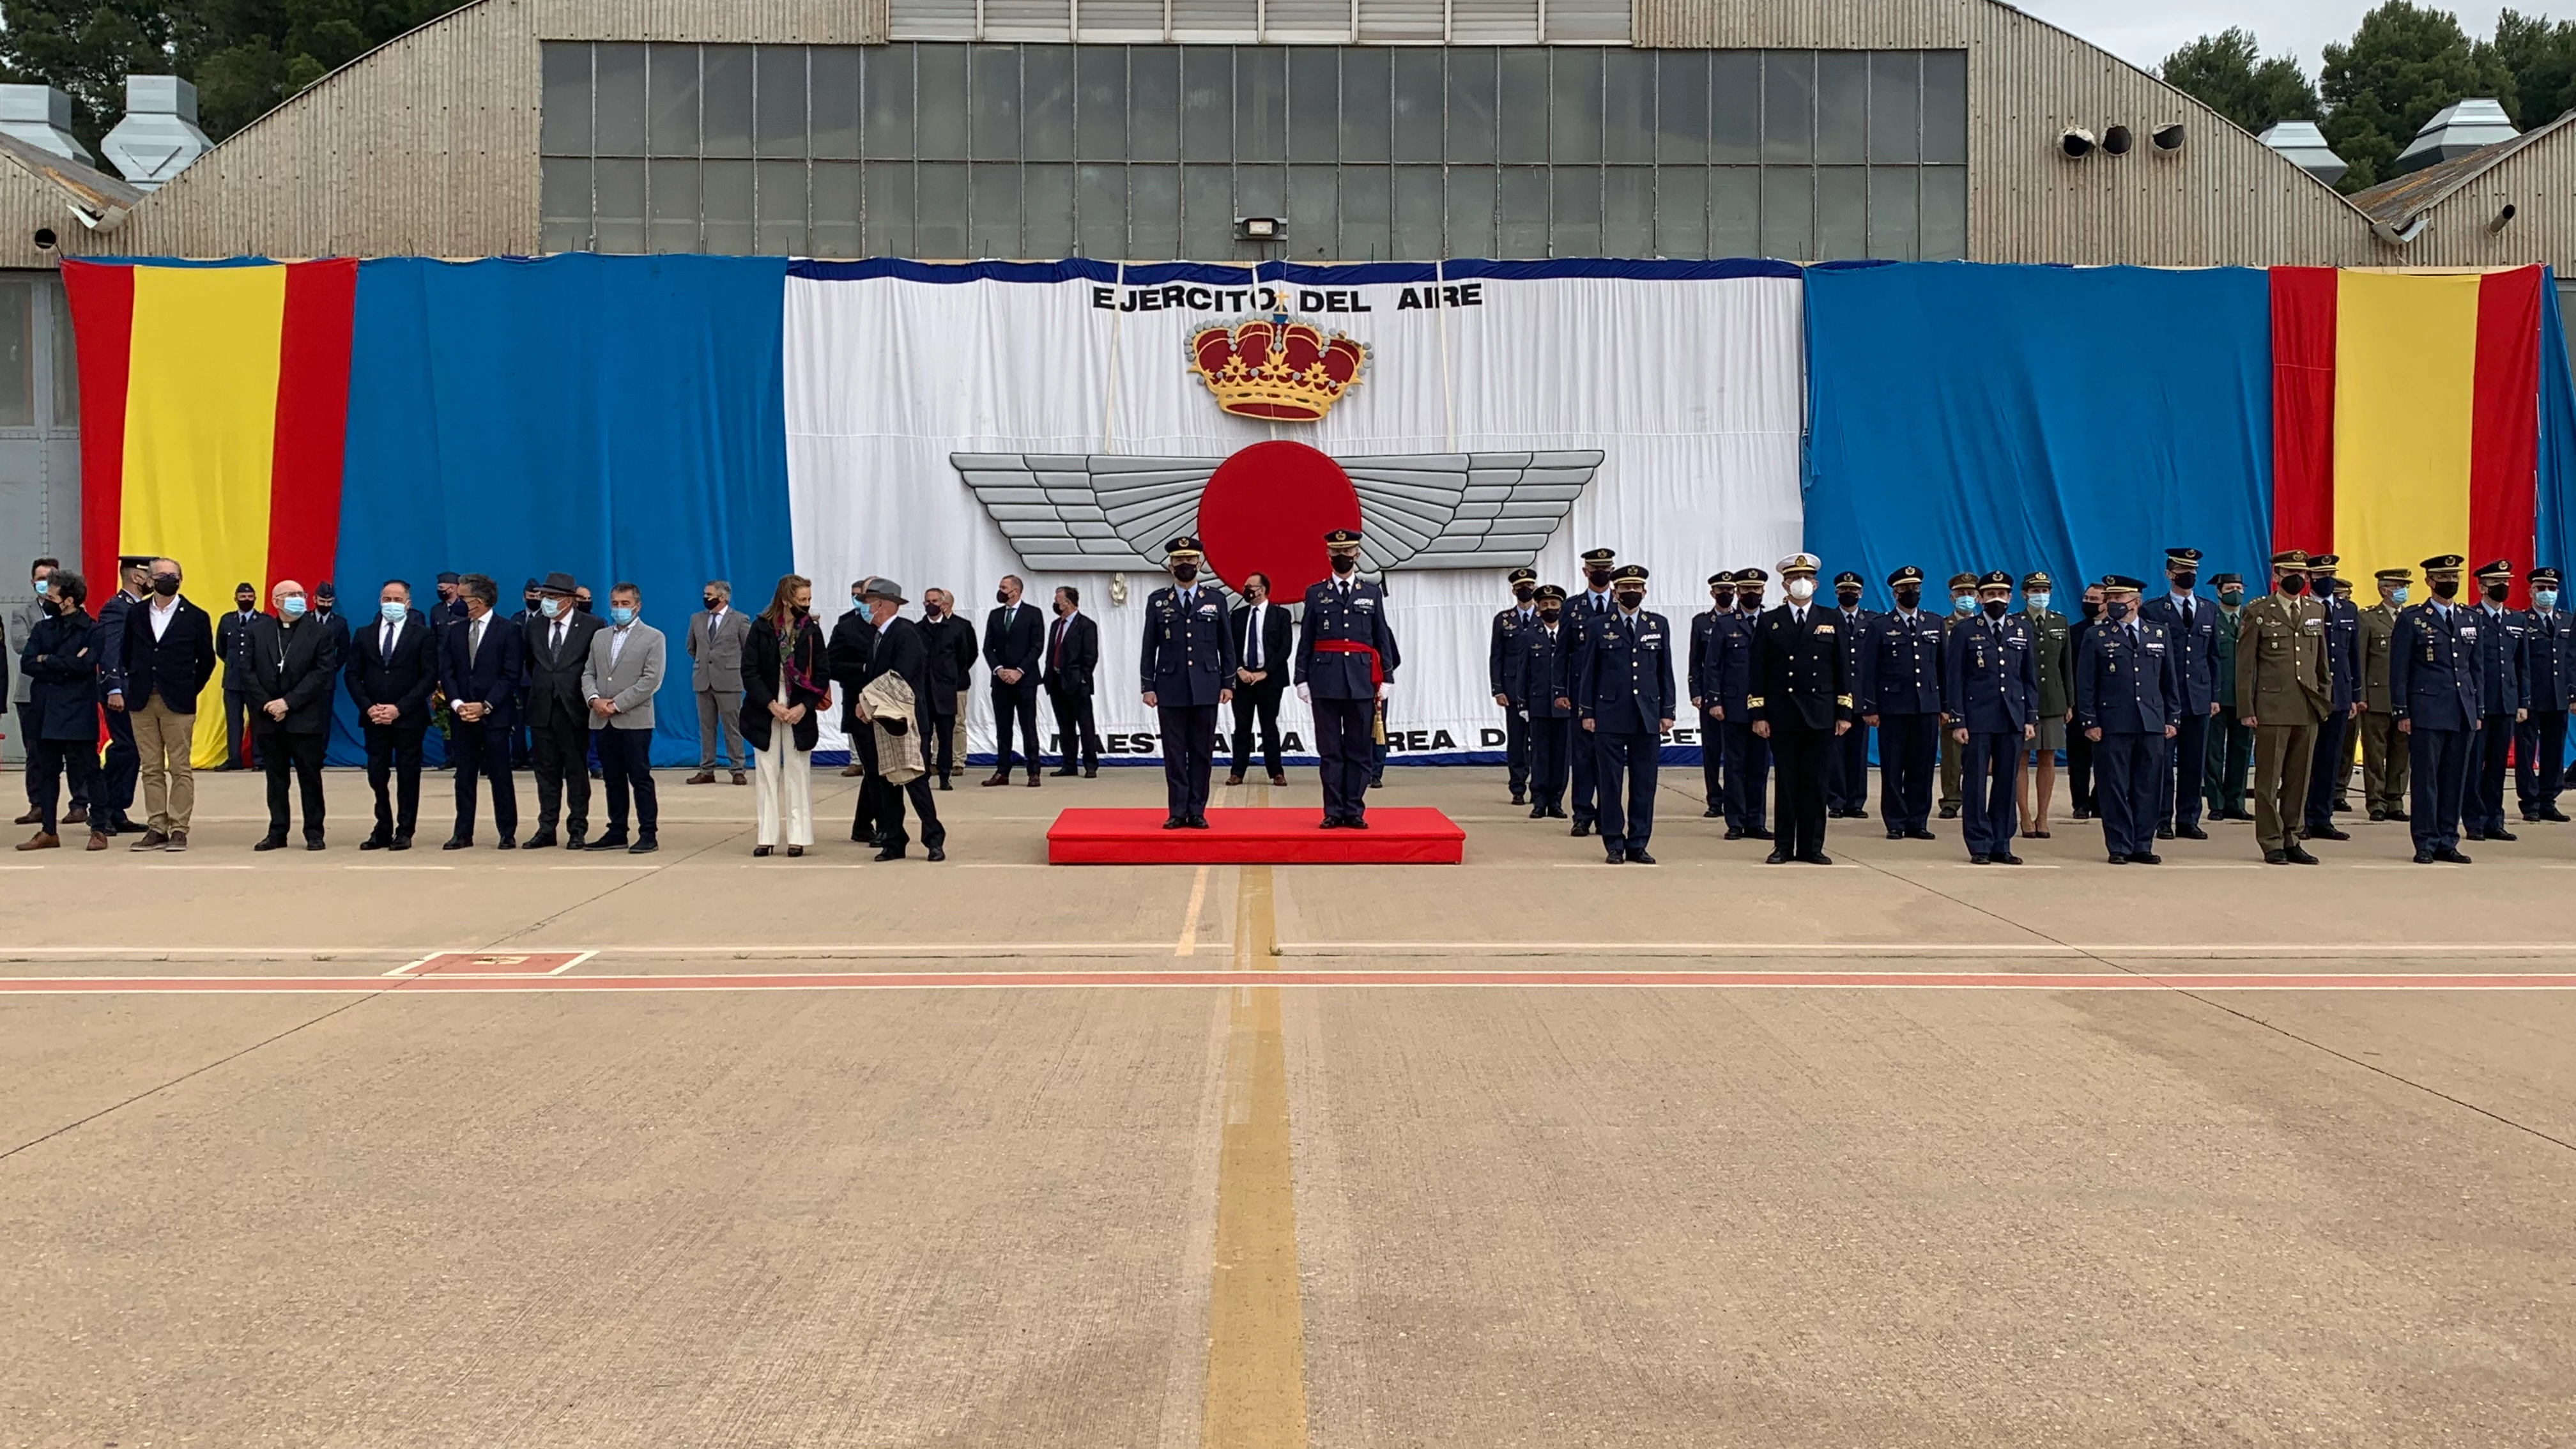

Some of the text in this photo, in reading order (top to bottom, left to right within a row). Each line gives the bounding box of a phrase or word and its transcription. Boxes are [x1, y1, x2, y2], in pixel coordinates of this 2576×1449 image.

[1093, 283, 1482, 312] EJERCITO DEL AIRE
